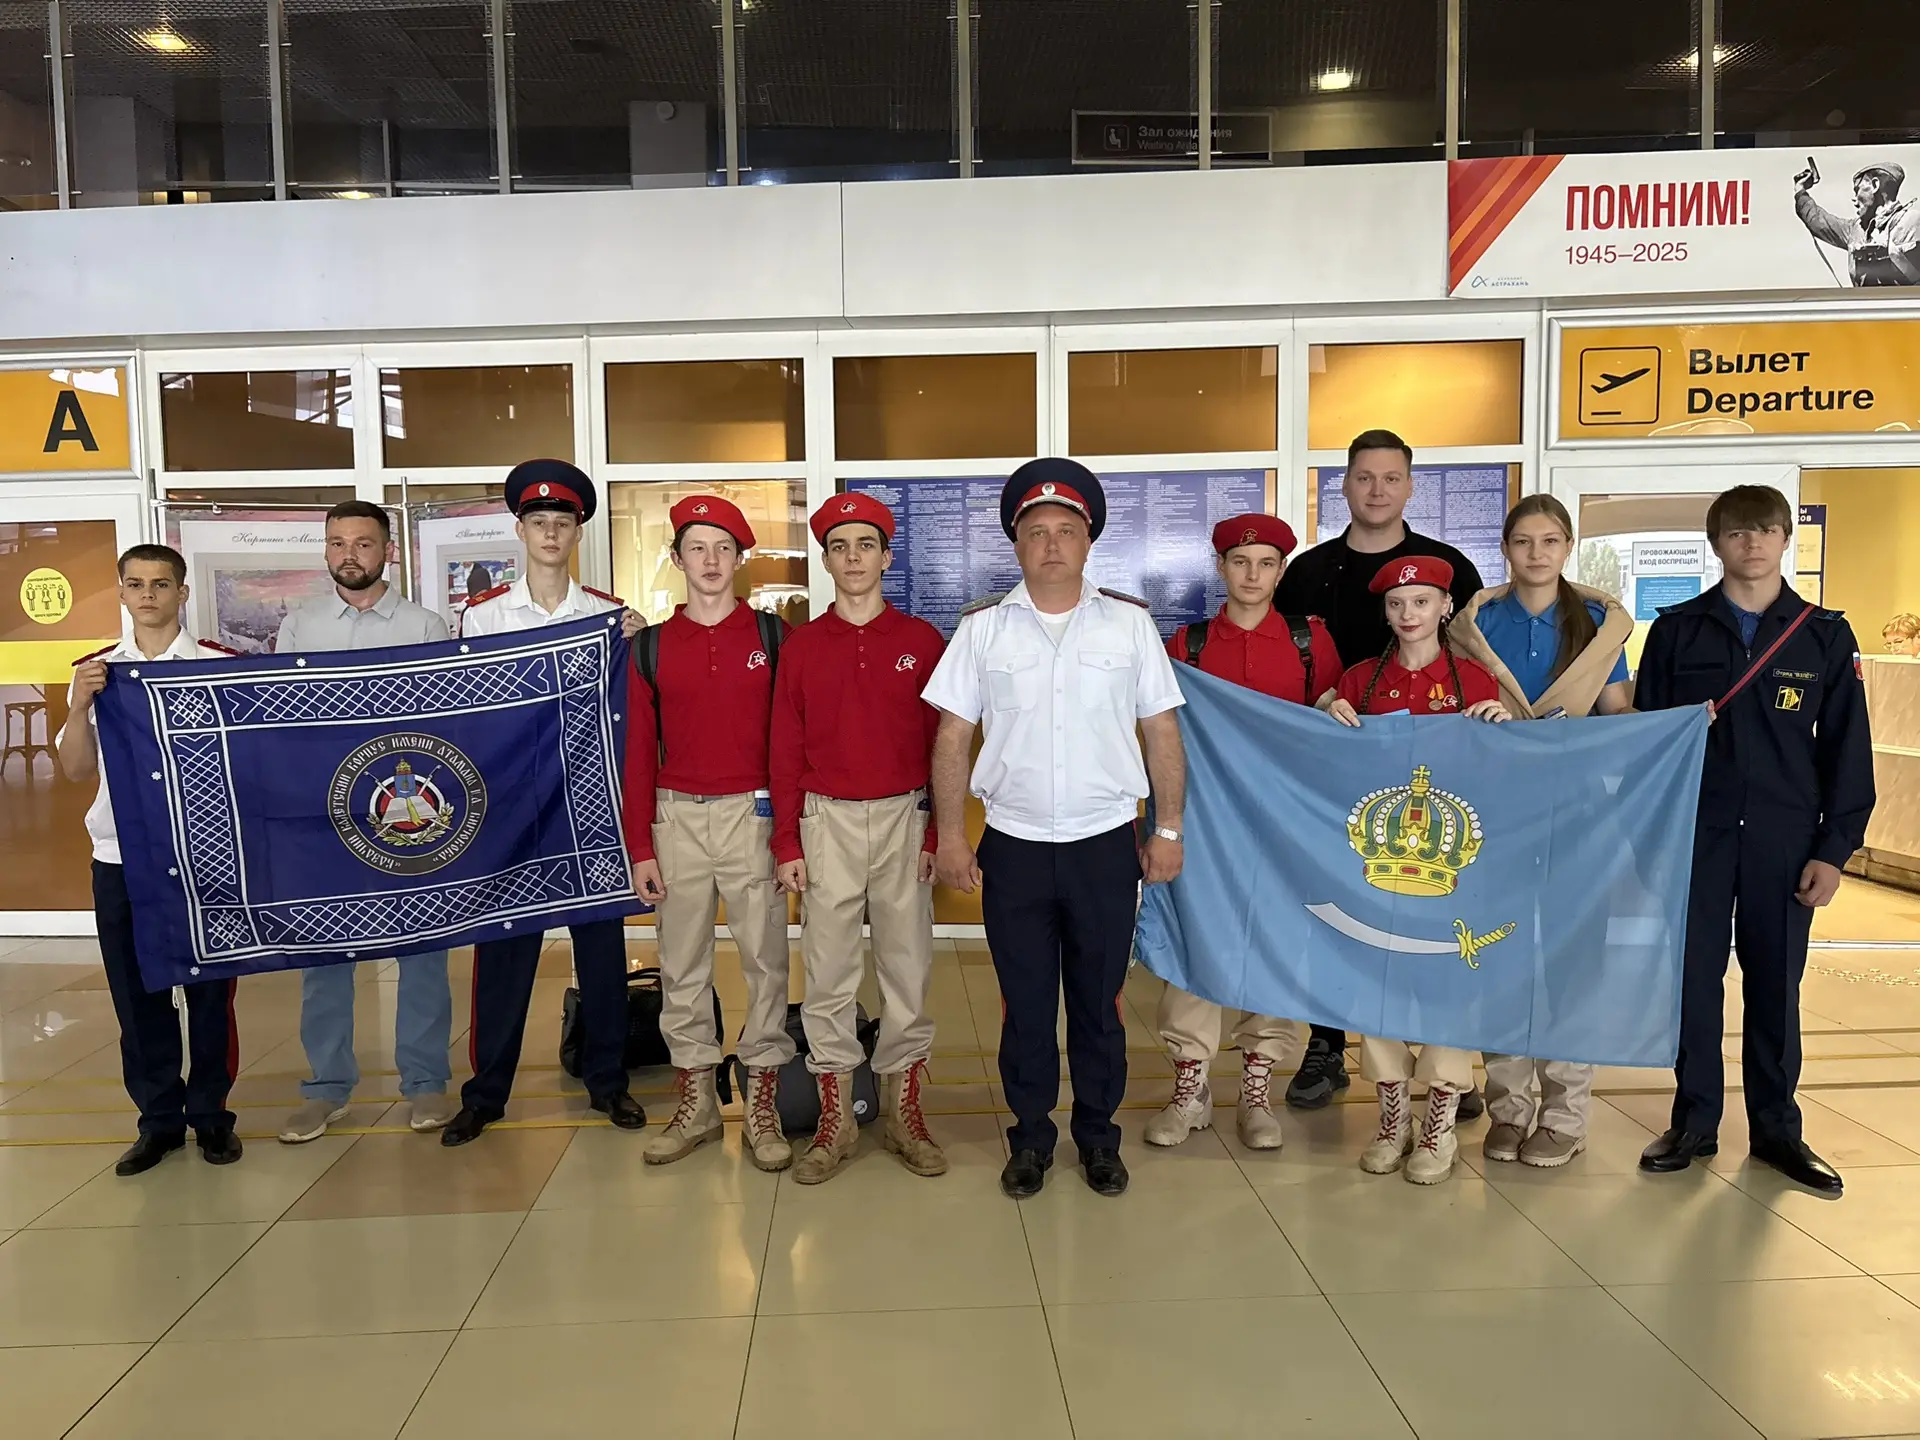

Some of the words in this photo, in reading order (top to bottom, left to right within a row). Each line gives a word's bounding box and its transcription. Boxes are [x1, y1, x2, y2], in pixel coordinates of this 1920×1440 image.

[1138, 126, 1164, 137] Зал
[1167, 128, 1233, 140] ожидния
[1566, 180, 1750, 231] ПОМНИМ!
[1689, 349, 1810, 375] Вылет
[1687, 386, 1874, 418] Departure
[232, 532, 284, 546] Картина
[1640, 548, 1698, 556] ПРОВОЖАЮЩИМ
[1658, 557, 1699, 565] ВОСПРЕЩЕН
[346, 740, 386, 772] КОРПУС
[391, 736, 434, 750] ИМЕНИ
[437, 745, 478, 787] АТАМАНА
